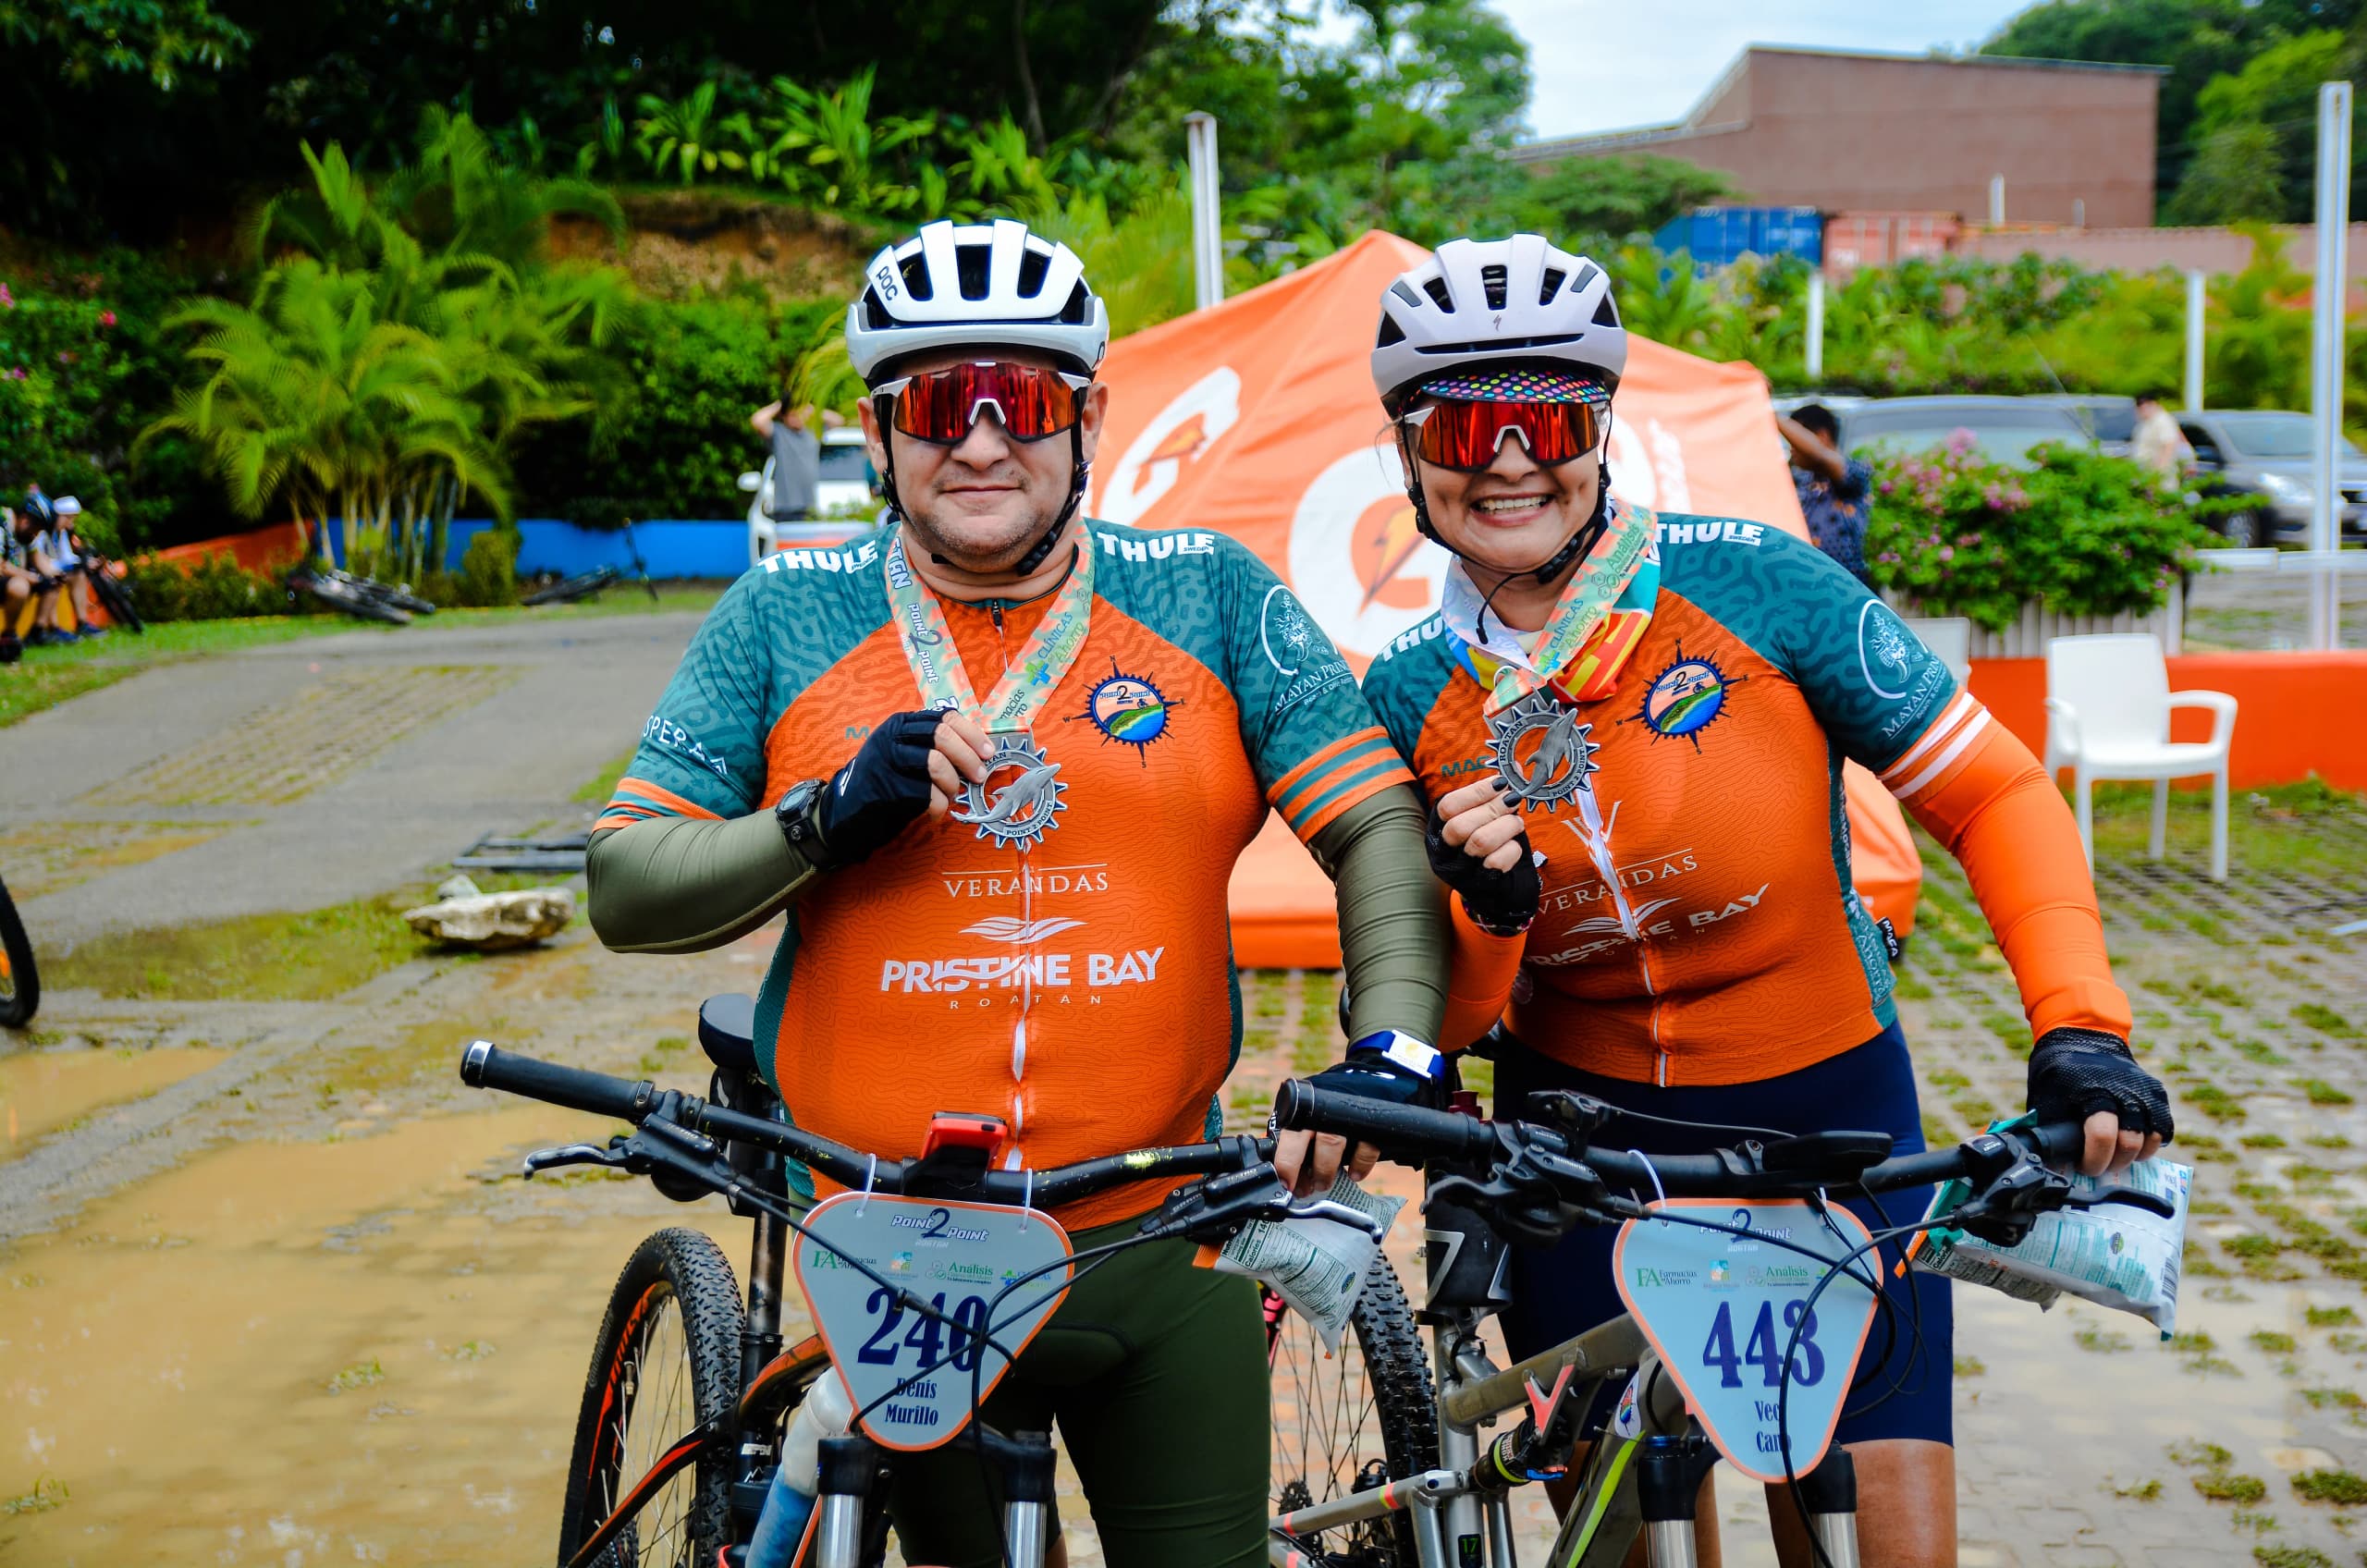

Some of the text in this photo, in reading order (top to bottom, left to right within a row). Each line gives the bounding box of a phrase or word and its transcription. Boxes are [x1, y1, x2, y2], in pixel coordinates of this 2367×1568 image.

[876, 265, 899, 301] POC
[1097, 531, 1214, 562] THULE
[1656, 521, 1764, 546] THULE
[757, 539, 878, 574] THULE
[1037, 611, 1073, 659] CLÍNICAS
[1379, 615, 1443, 662] THU
[1550, 598, 1584, 649] CLÍNICAS
[1564, 606, 1598, 648] Ahorro
[909, 630, 943, 651] 2
[999, 688, 1025, 719] macias
[1117, 684, 1131, 701] 2
[1274, 671, 1322, 712] MAYAN
[1882, 682, 1928, 738] MAYAN
[1500, 720, 1524, 762] ROATAN
[1552, 785, 1572, 797] POINT
[1006, 827, 1031, 836] POINT
[1038, 802, 1052, 827] POINT
[943, 871, 1110, 898] VERANDAS
[1687, 882, 1771, 926] BAY
[881, 946, 1165, 993] PRISTINE BAY
[950, 994, 1101, 1010] ROATAN
[921, 1207, 950, 1239] 2
[948, 1260, 994, 1276] Análisis
[1245, 1239, 1262, 1268] Calories
[1636, 1267, 1663, 1288] FA
[1659, 1269, 1698, 1278] Farmacias
[1665, 1278, 1691, 1286] Ahorro
[1766, 1265, 1809, 1277] Análisis
[857, 1288, 988, 1373] 240
[1702, 1299, 1826, 1389] 443
[895, 1377, 938, 1400] Denis
[885, 1403, 939, 1427] Murillo
[1461, 1537, 1478, 1554] 17
